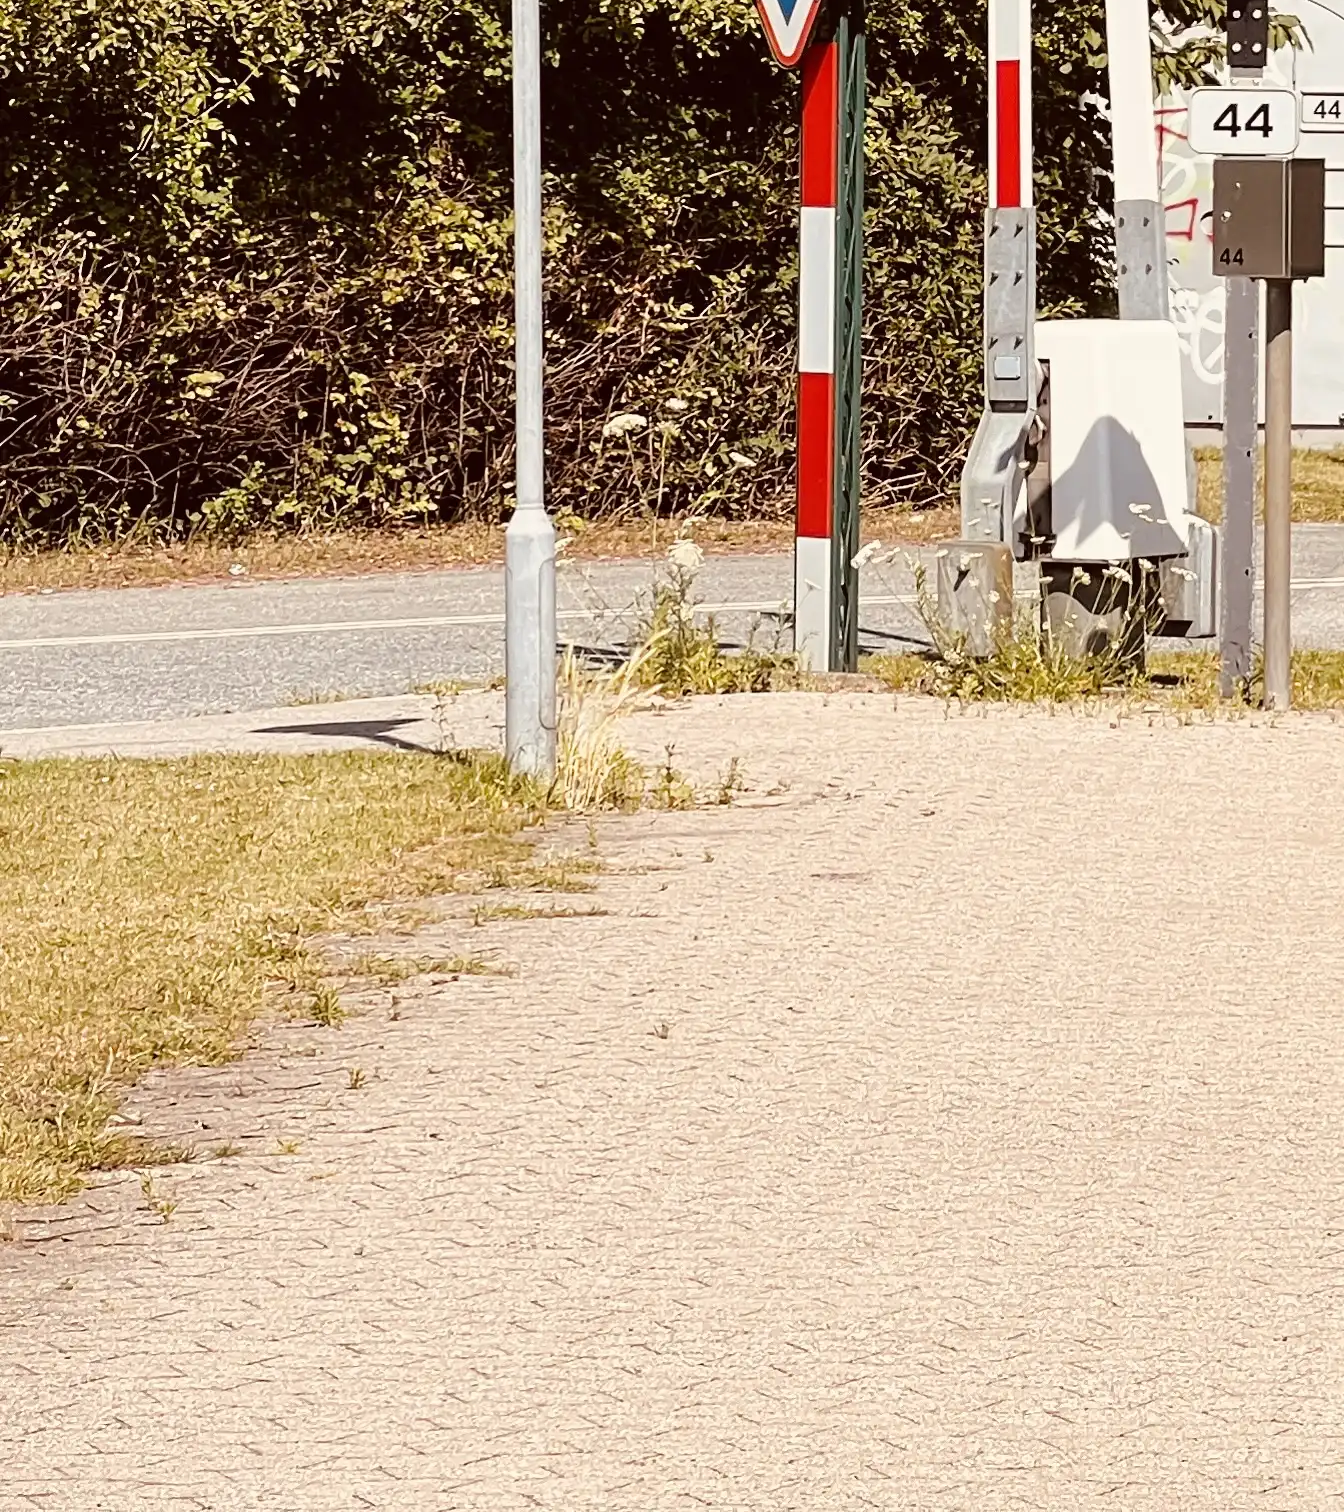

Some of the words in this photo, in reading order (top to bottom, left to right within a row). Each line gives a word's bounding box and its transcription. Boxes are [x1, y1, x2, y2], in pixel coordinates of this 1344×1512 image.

[1313, 99, 1342, 119] 44
[1213, 103, 1273, 138] 44
[1219, 248, 1244, 266] 44
